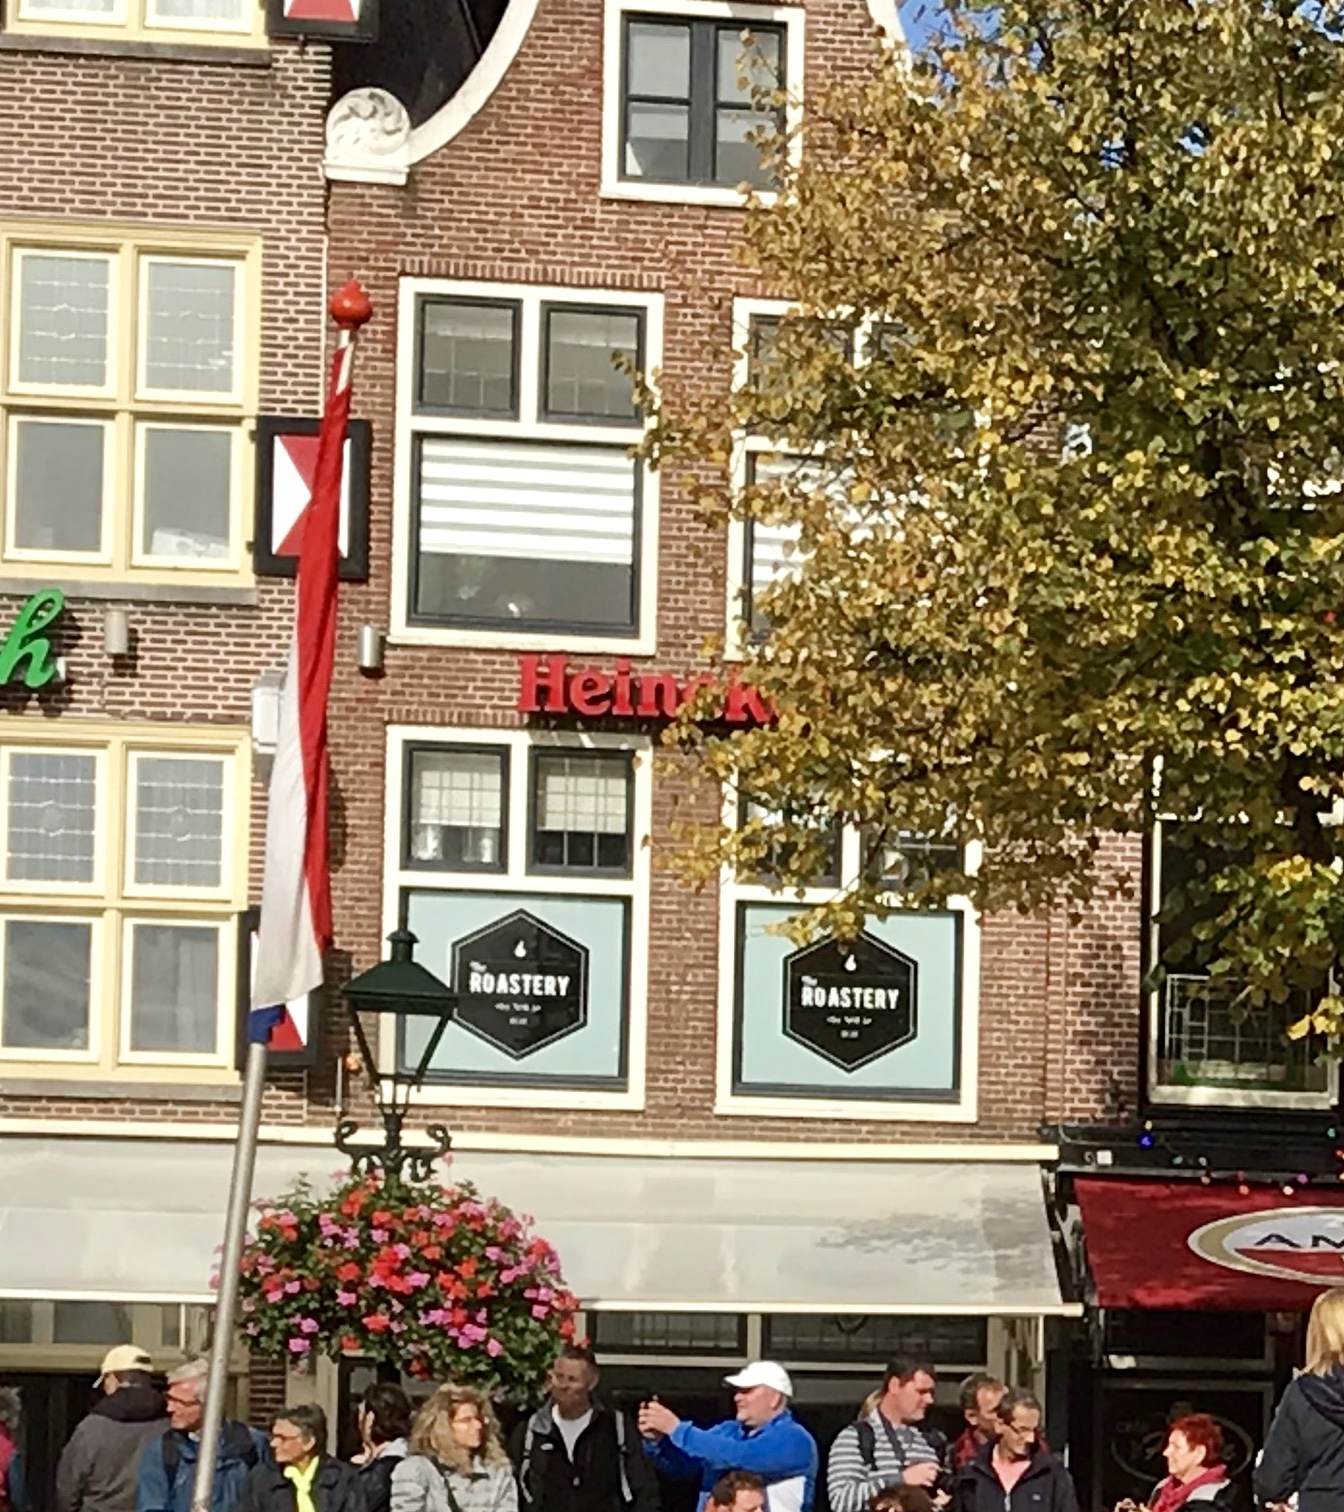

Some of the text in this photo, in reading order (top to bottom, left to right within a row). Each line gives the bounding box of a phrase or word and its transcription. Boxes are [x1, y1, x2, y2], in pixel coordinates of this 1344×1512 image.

[516, 654, 784, 723] Heink
[469, 971, 570, 996] ROASTERY
[801, 986, 899, 1009] ROASTERY
